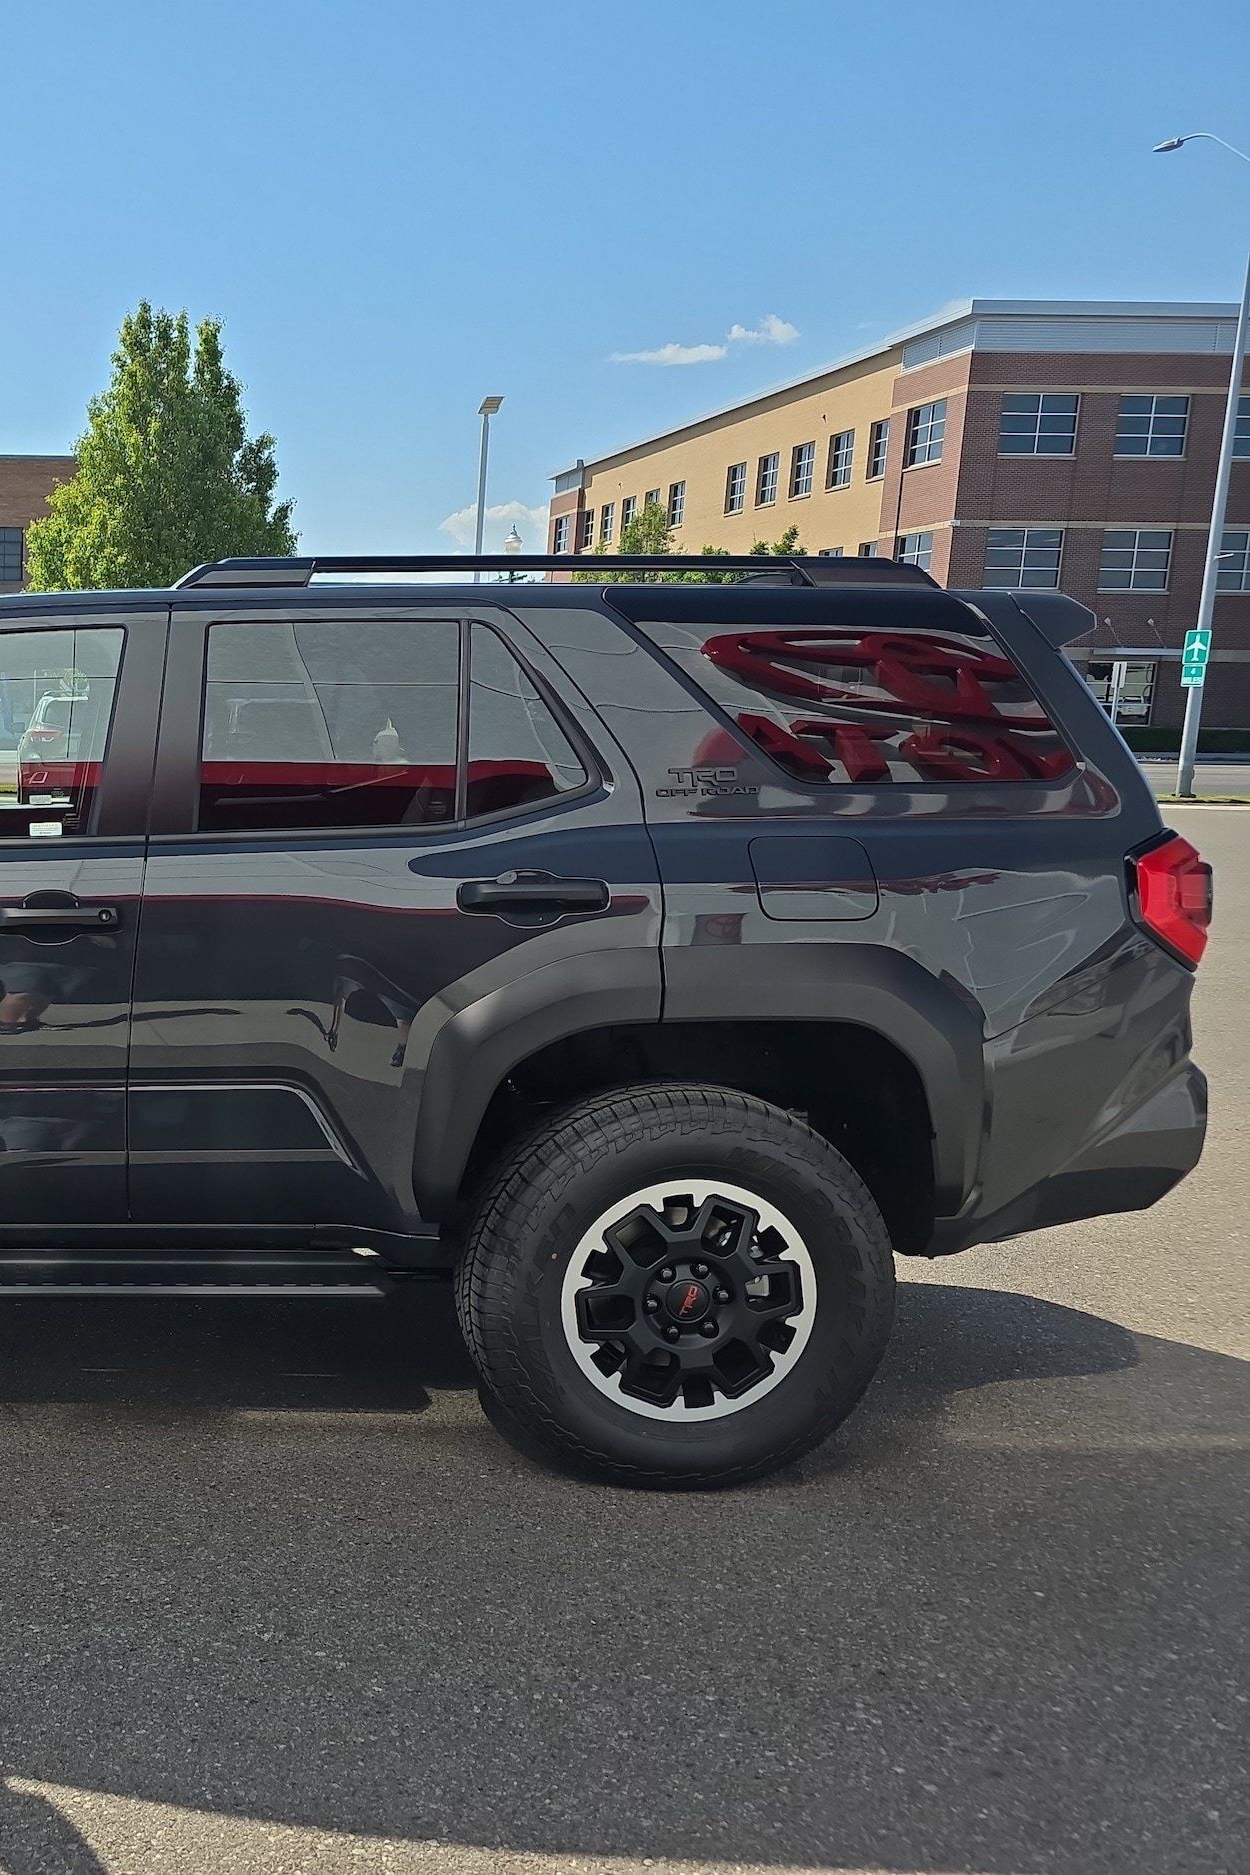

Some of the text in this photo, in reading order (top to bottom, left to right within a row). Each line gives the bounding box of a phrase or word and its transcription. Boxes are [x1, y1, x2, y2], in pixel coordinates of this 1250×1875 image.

[668, 766, 739, 788] TRD
[655, 786, 759, 798] OFF ROAD
[679, 1285, 698, 1315] TRD
